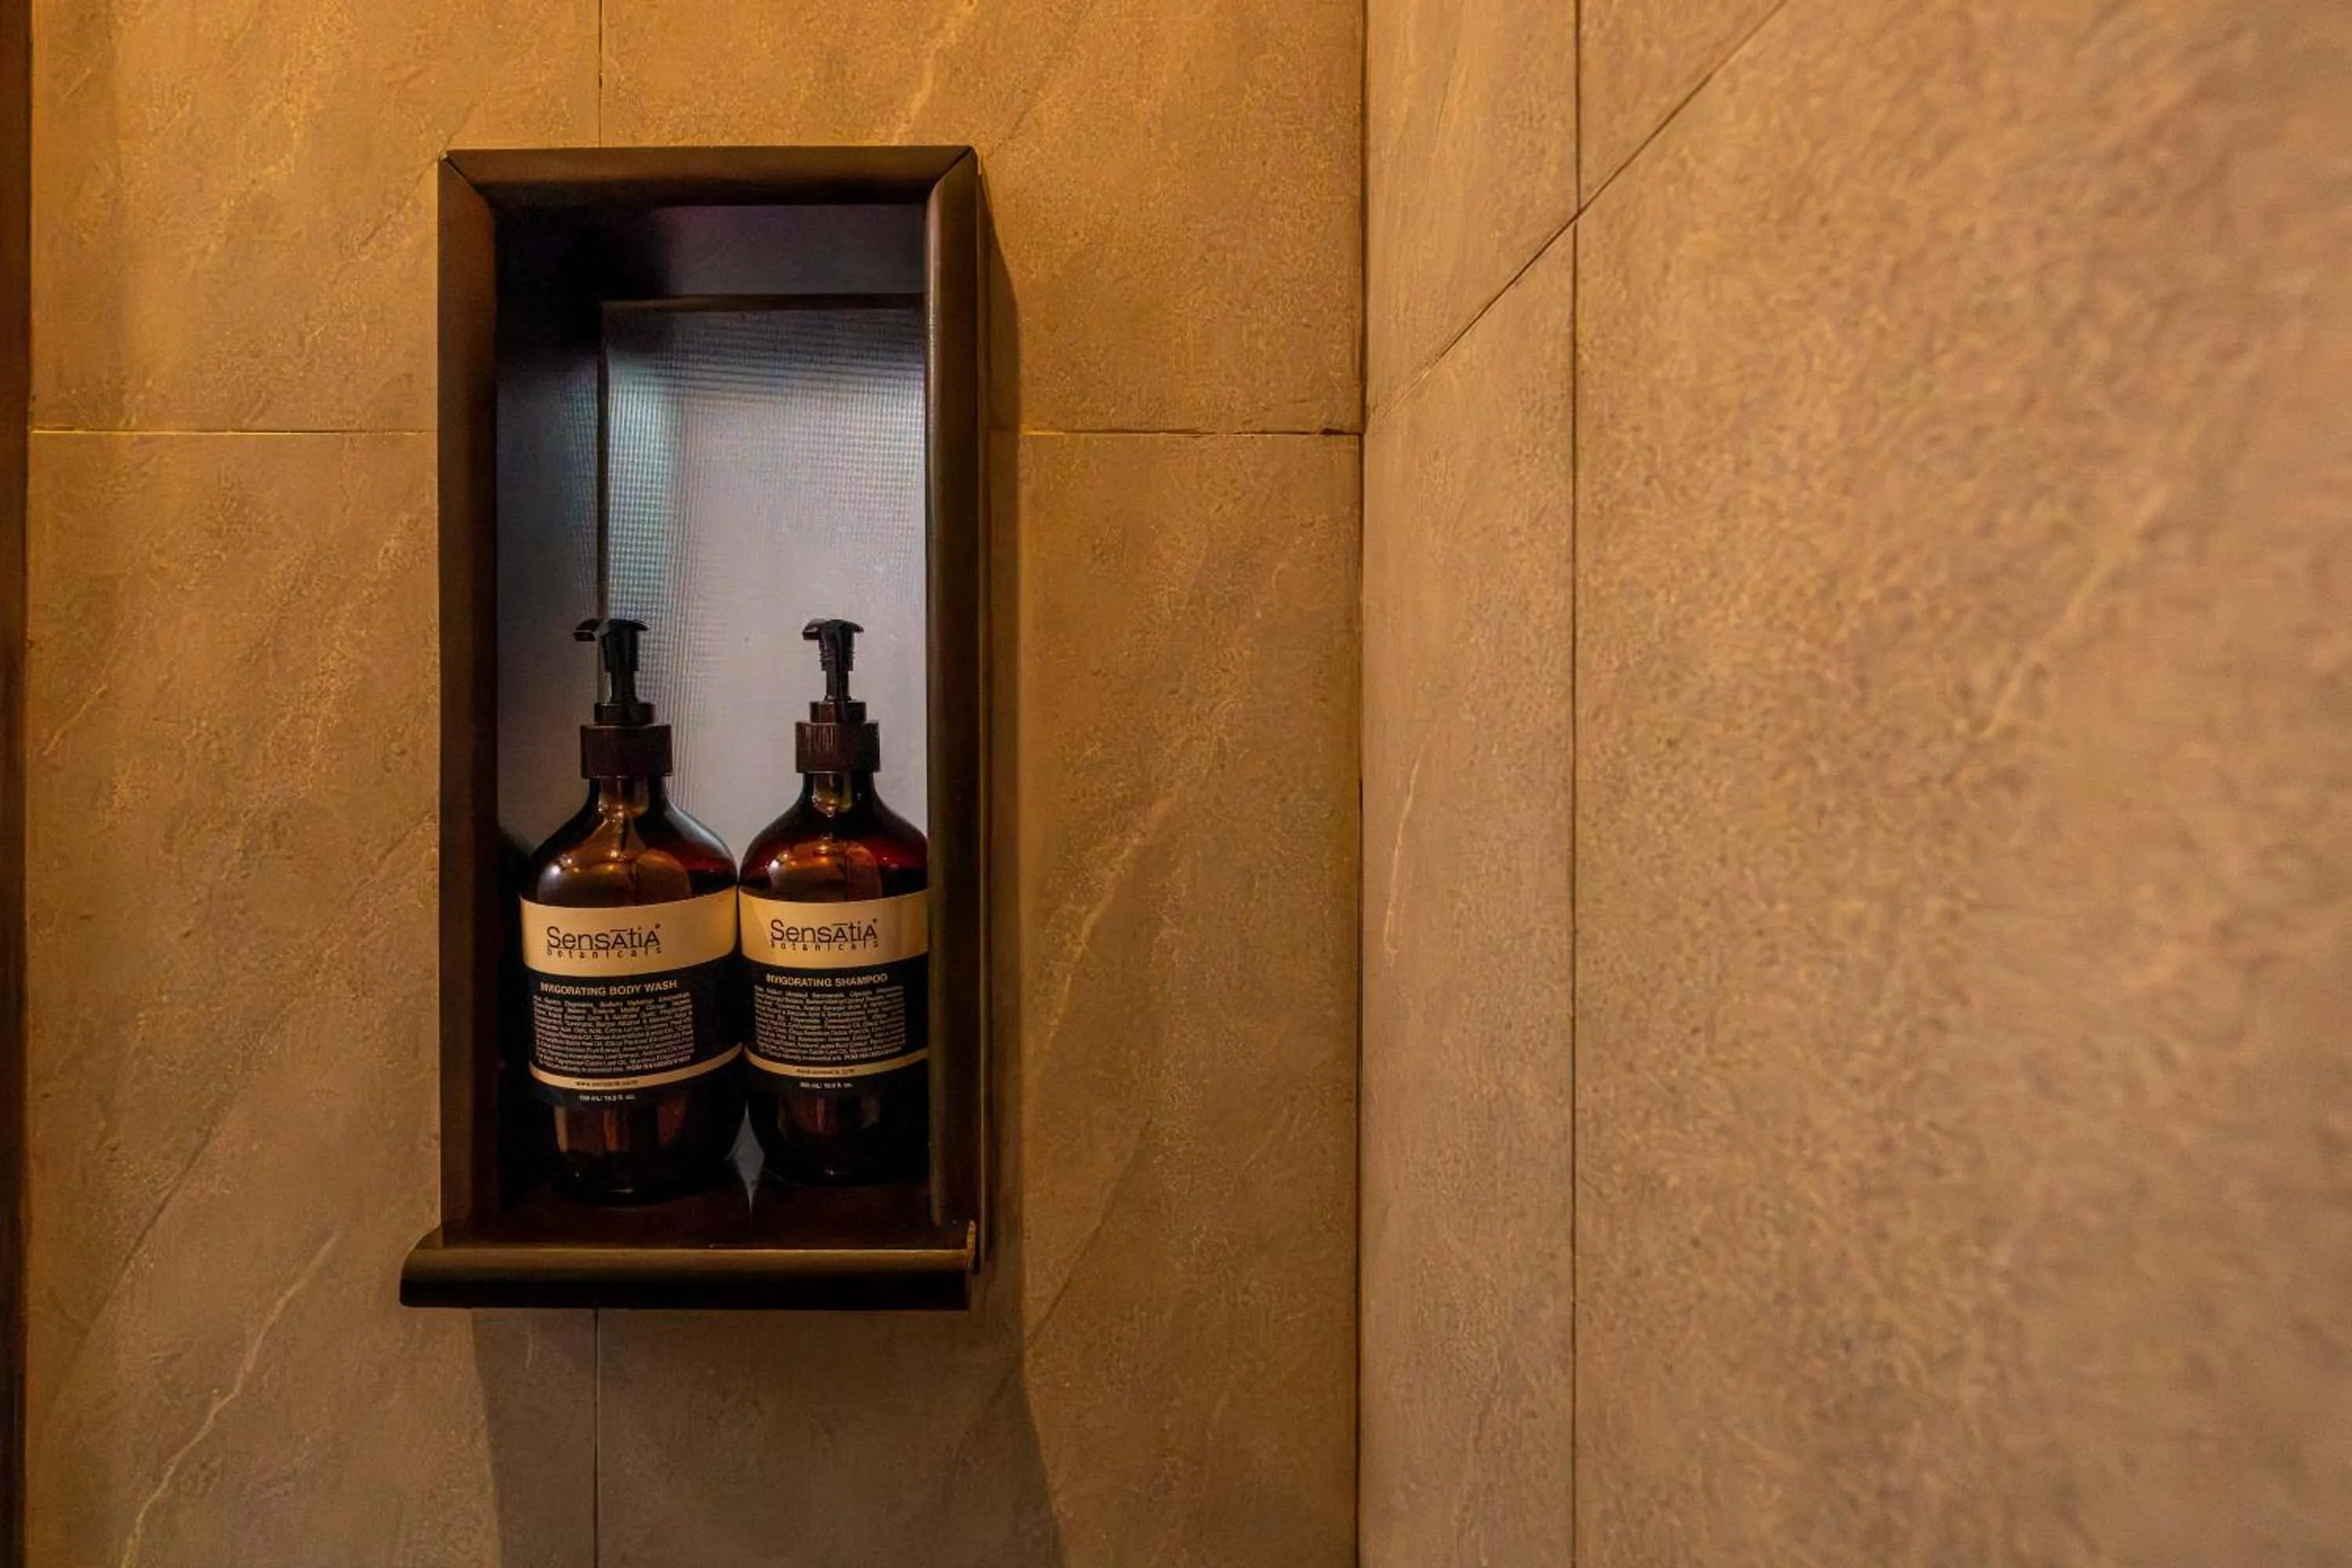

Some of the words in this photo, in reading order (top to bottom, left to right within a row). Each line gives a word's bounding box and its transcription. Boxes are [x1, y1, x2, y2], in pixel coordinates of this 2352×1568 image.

[766, 973, 833, 987] INVIGORATING
[835, 973, 888, 987] SHAMPOO
[540, 982, 606, 996] INVIGORATING
[609, 983, 641, 996] BODY
[644, 980, 677, 993] WASH
